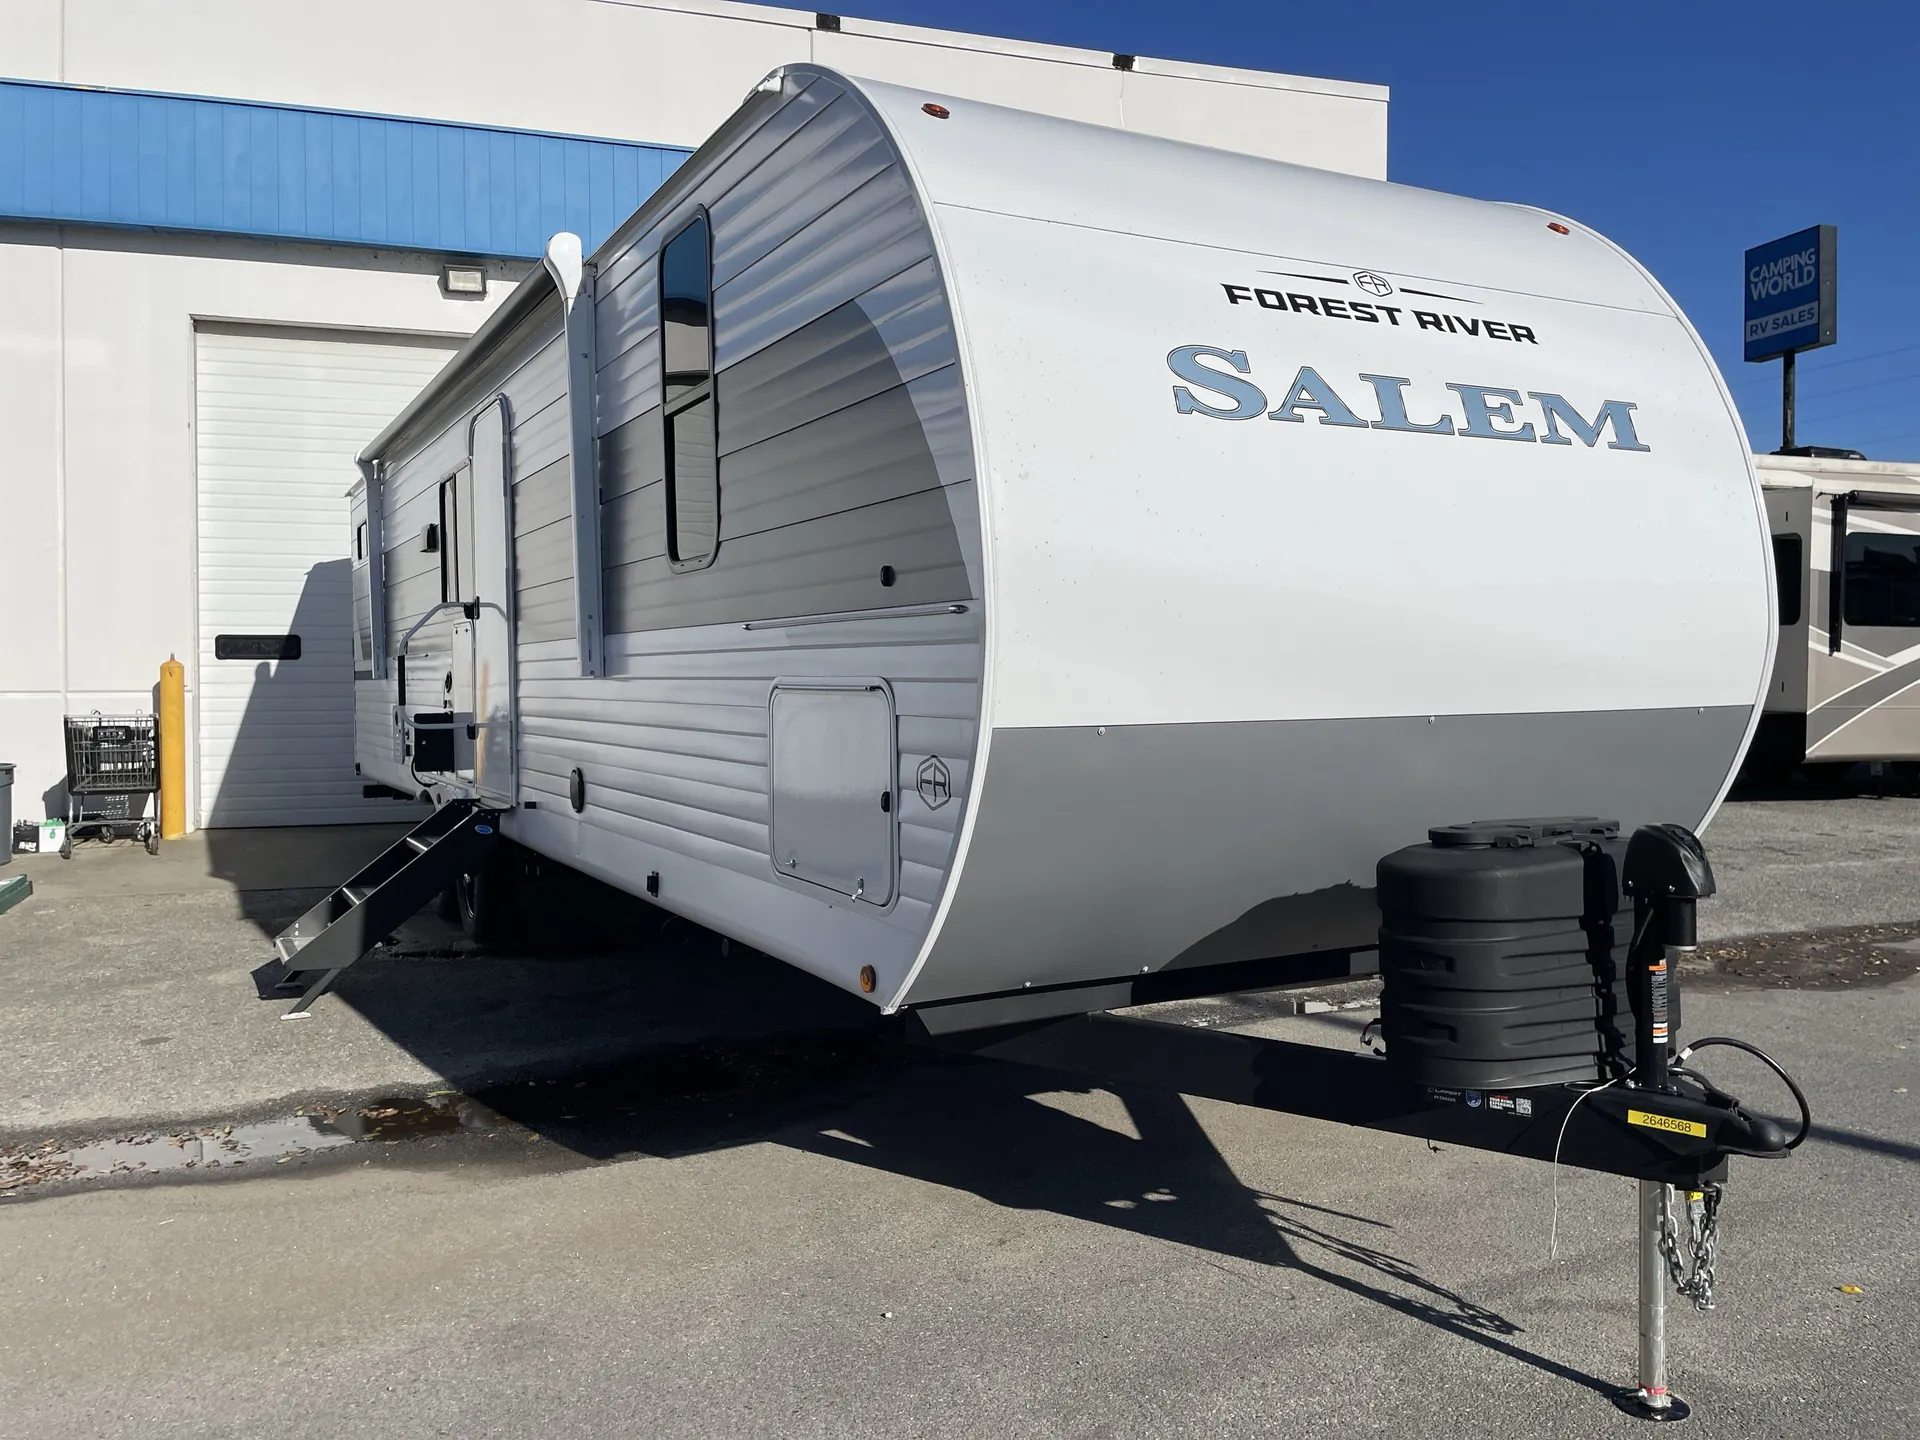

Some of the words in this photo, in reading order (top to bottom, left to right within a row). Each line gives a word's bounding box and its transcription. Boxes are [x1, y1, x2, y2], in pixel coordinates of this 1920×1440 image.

[1750, 248, 1816, 282] CAMPING
[1750, 266, 1816, 300] WORLD
[1220, 283, 1402, 326] FOREST
[1410, 309, 1540, 345] RIVER
[1750, 321, 1768, 336] RV
[1771, 307, 1815, 330] SALES
[1166, 344, 1651, 452] SALEM
[1642, 1114, 1692, 1133] 2646568
